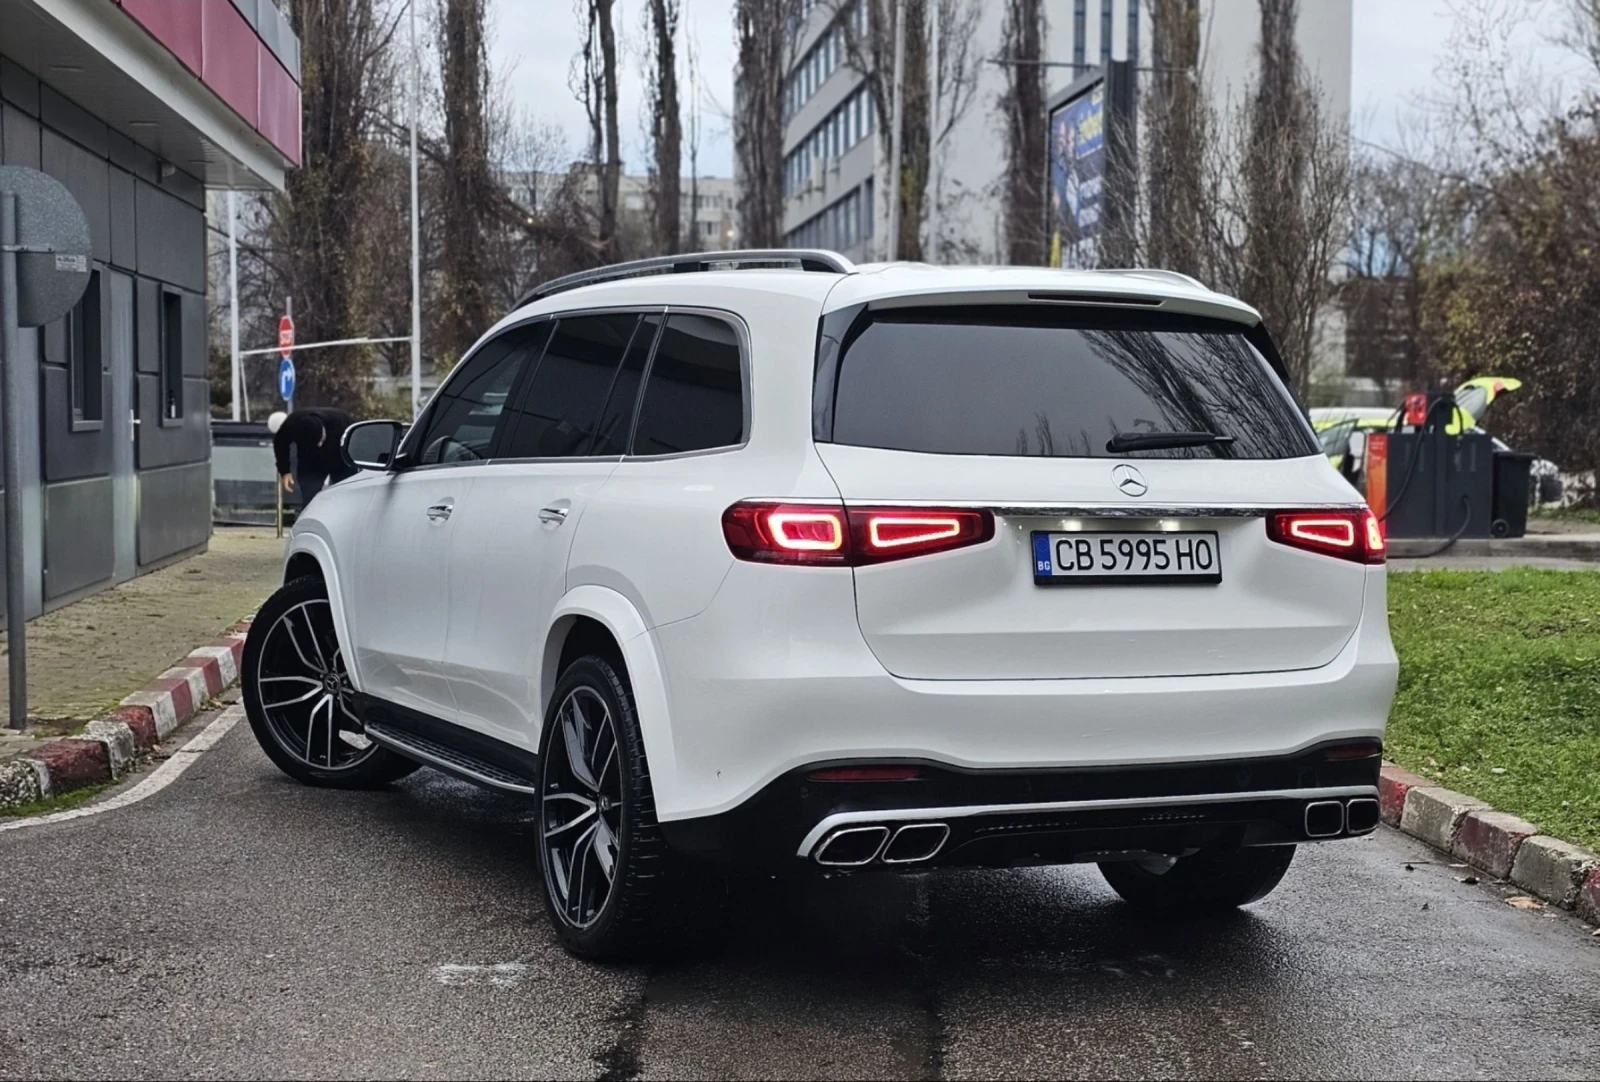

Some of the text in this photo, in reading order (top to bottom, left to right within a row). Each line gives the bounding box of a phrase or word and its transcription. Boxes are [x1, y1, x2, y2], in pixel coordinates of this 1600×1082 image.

[1056, 539, 1213, 571] CB 5995 HO
[1037, 561, 1051, 571] BG
